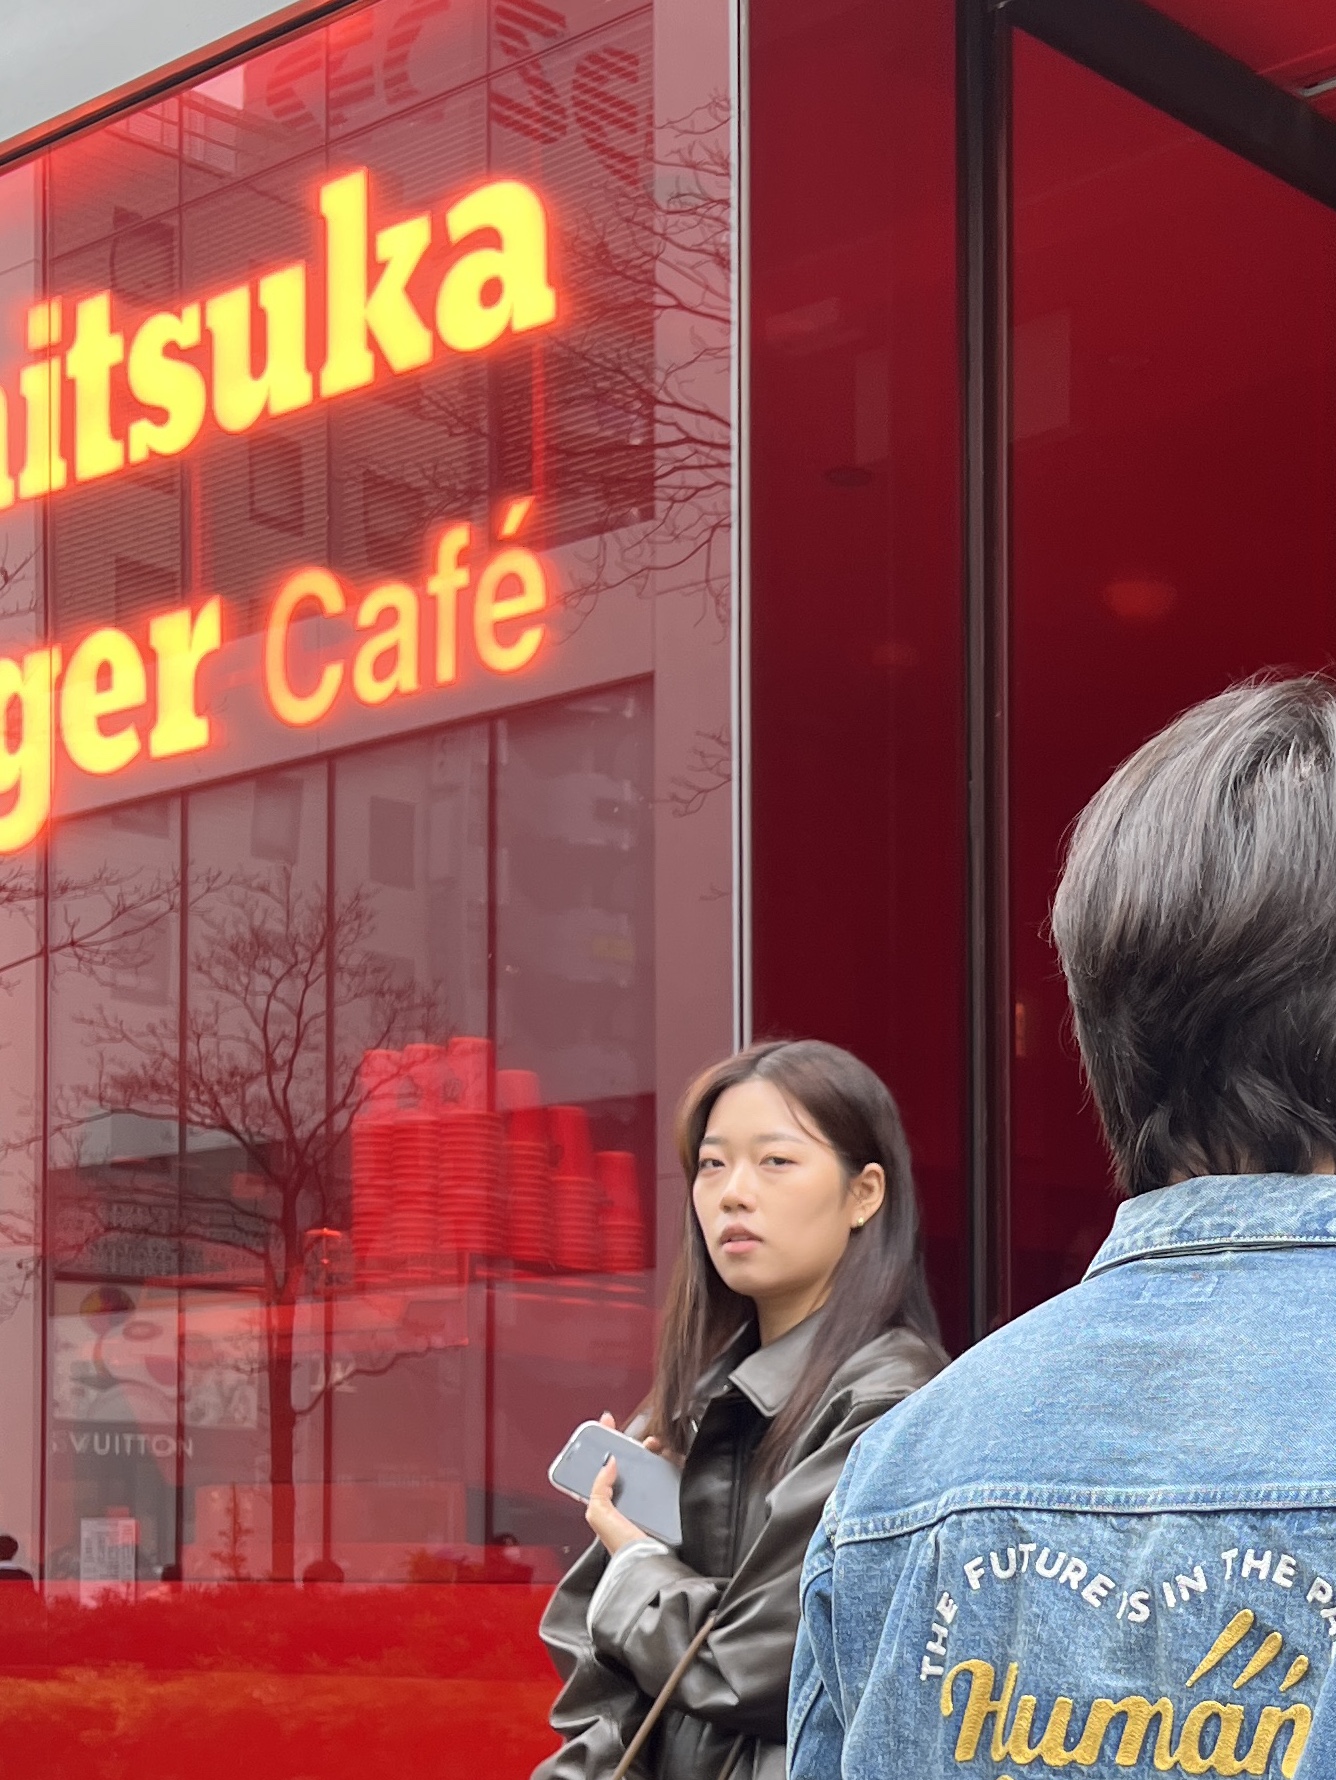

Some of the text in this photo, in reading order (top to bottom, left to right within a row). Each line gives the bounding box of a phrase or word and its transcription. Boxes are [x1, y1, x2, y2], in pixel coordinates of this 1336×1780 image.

[263, 496, 547, 727] Café
[920, 1591, 959, 1681] THE
[963, 1543, 1116, 1608] FUTURE
[1115, 1590, 1150, 1625] IS
[1162, 1565, 1208, 1607] IN
[1220, 1547, 1296, 1590] THE
[940, 1658, 1313, 1779] Human
